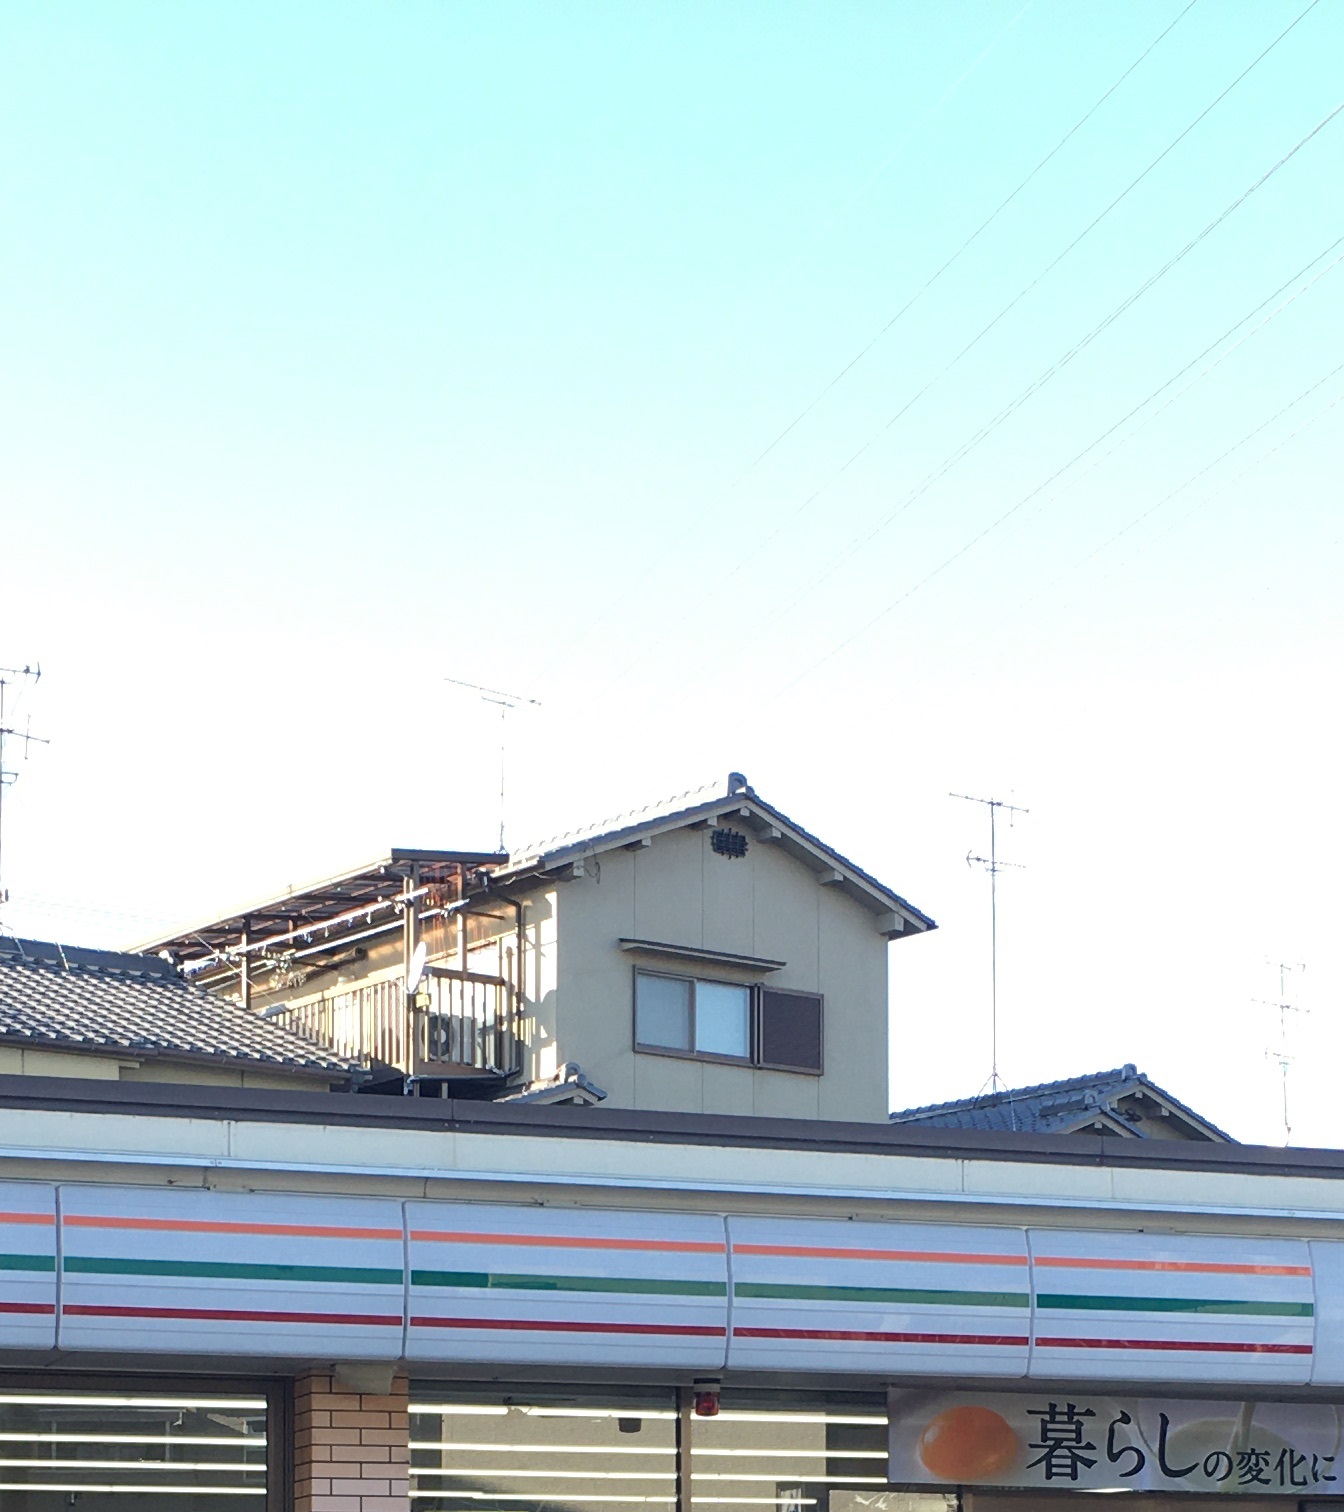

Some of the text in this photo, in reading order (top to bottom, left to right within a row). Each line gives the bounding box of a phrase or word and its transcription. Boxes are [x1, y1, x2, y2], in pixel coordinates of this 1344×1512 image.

[1024, 1401, 1338, 1487] 暮らしの変化に
